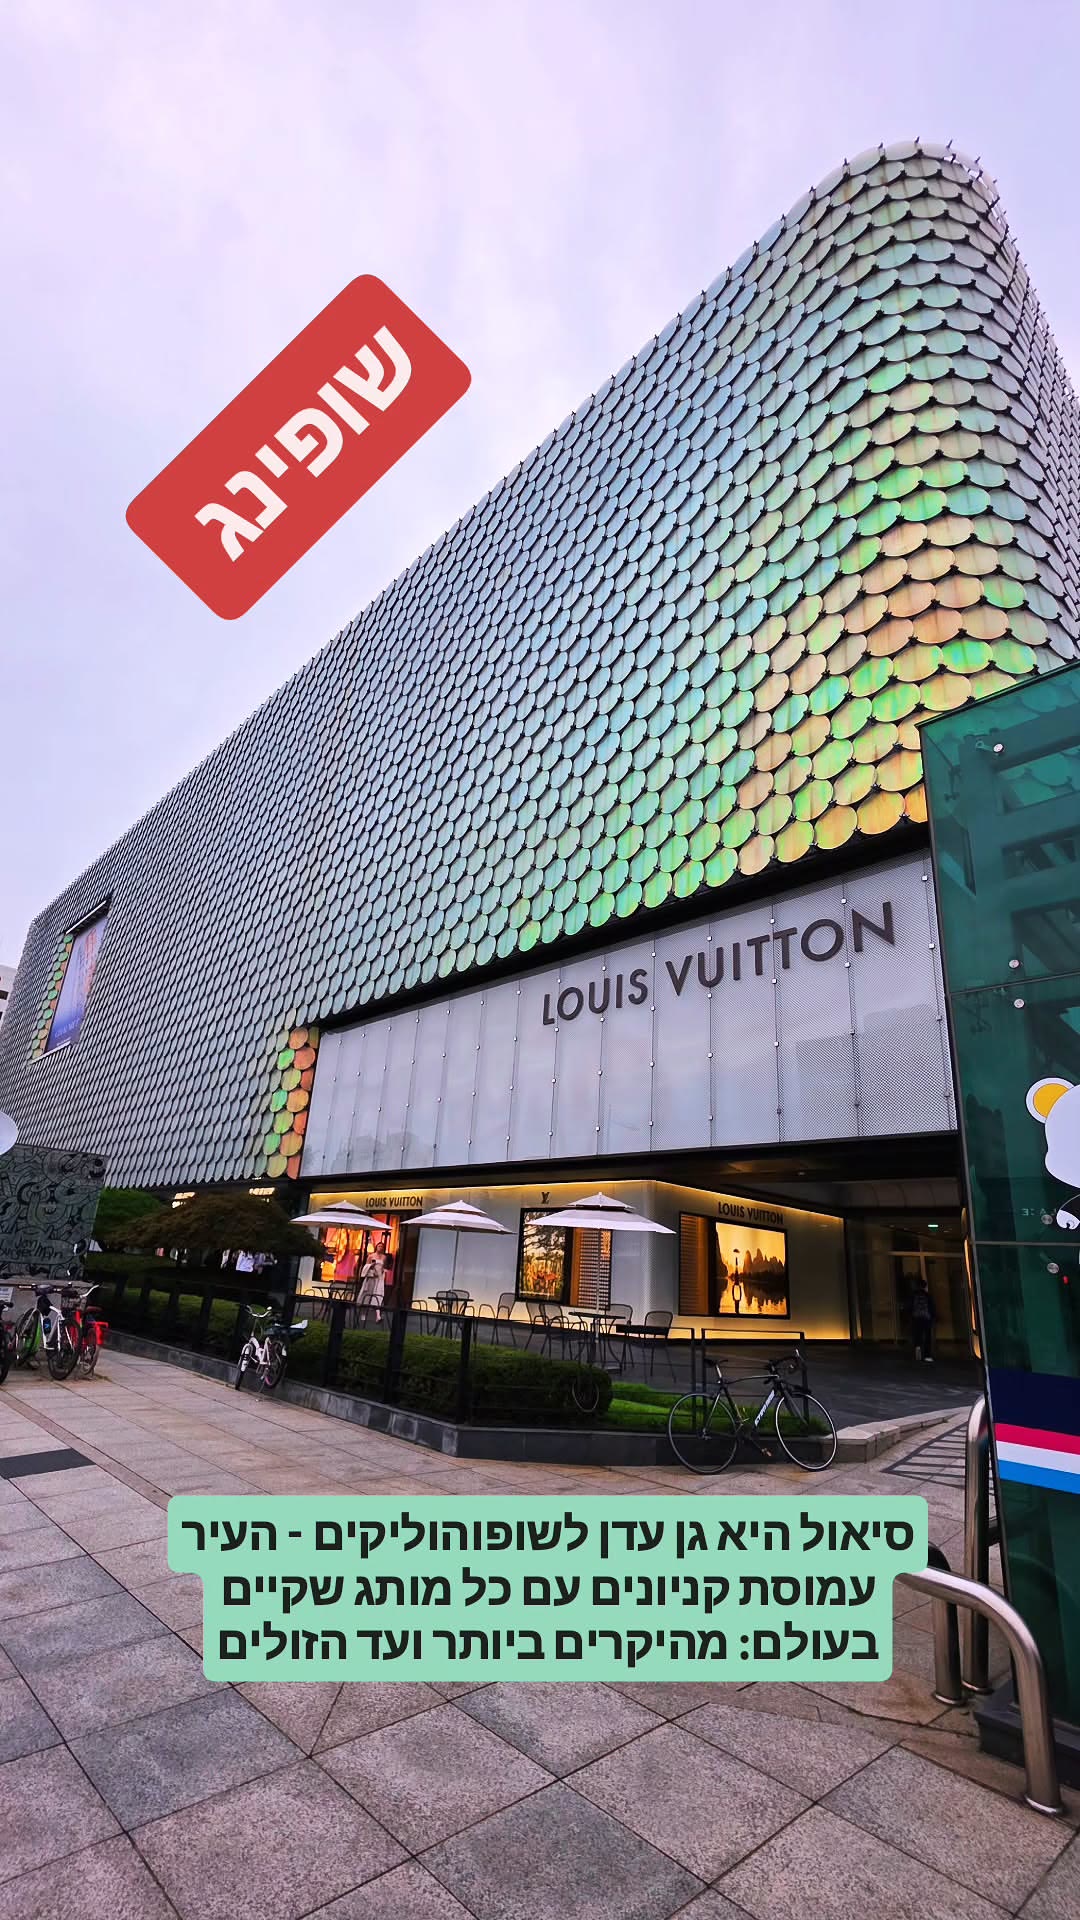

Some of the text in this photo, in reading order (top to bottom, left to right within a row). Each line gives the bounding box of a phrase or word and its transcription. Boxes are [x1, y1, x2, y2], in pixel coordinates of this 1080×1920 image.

[542, 901, 895, 1026] LOUIS VUITTON
[365, 1195, 424, 1208] LOUIS VUITTON
[718, 1201, 784, 1225] LOUIS VUITTON
